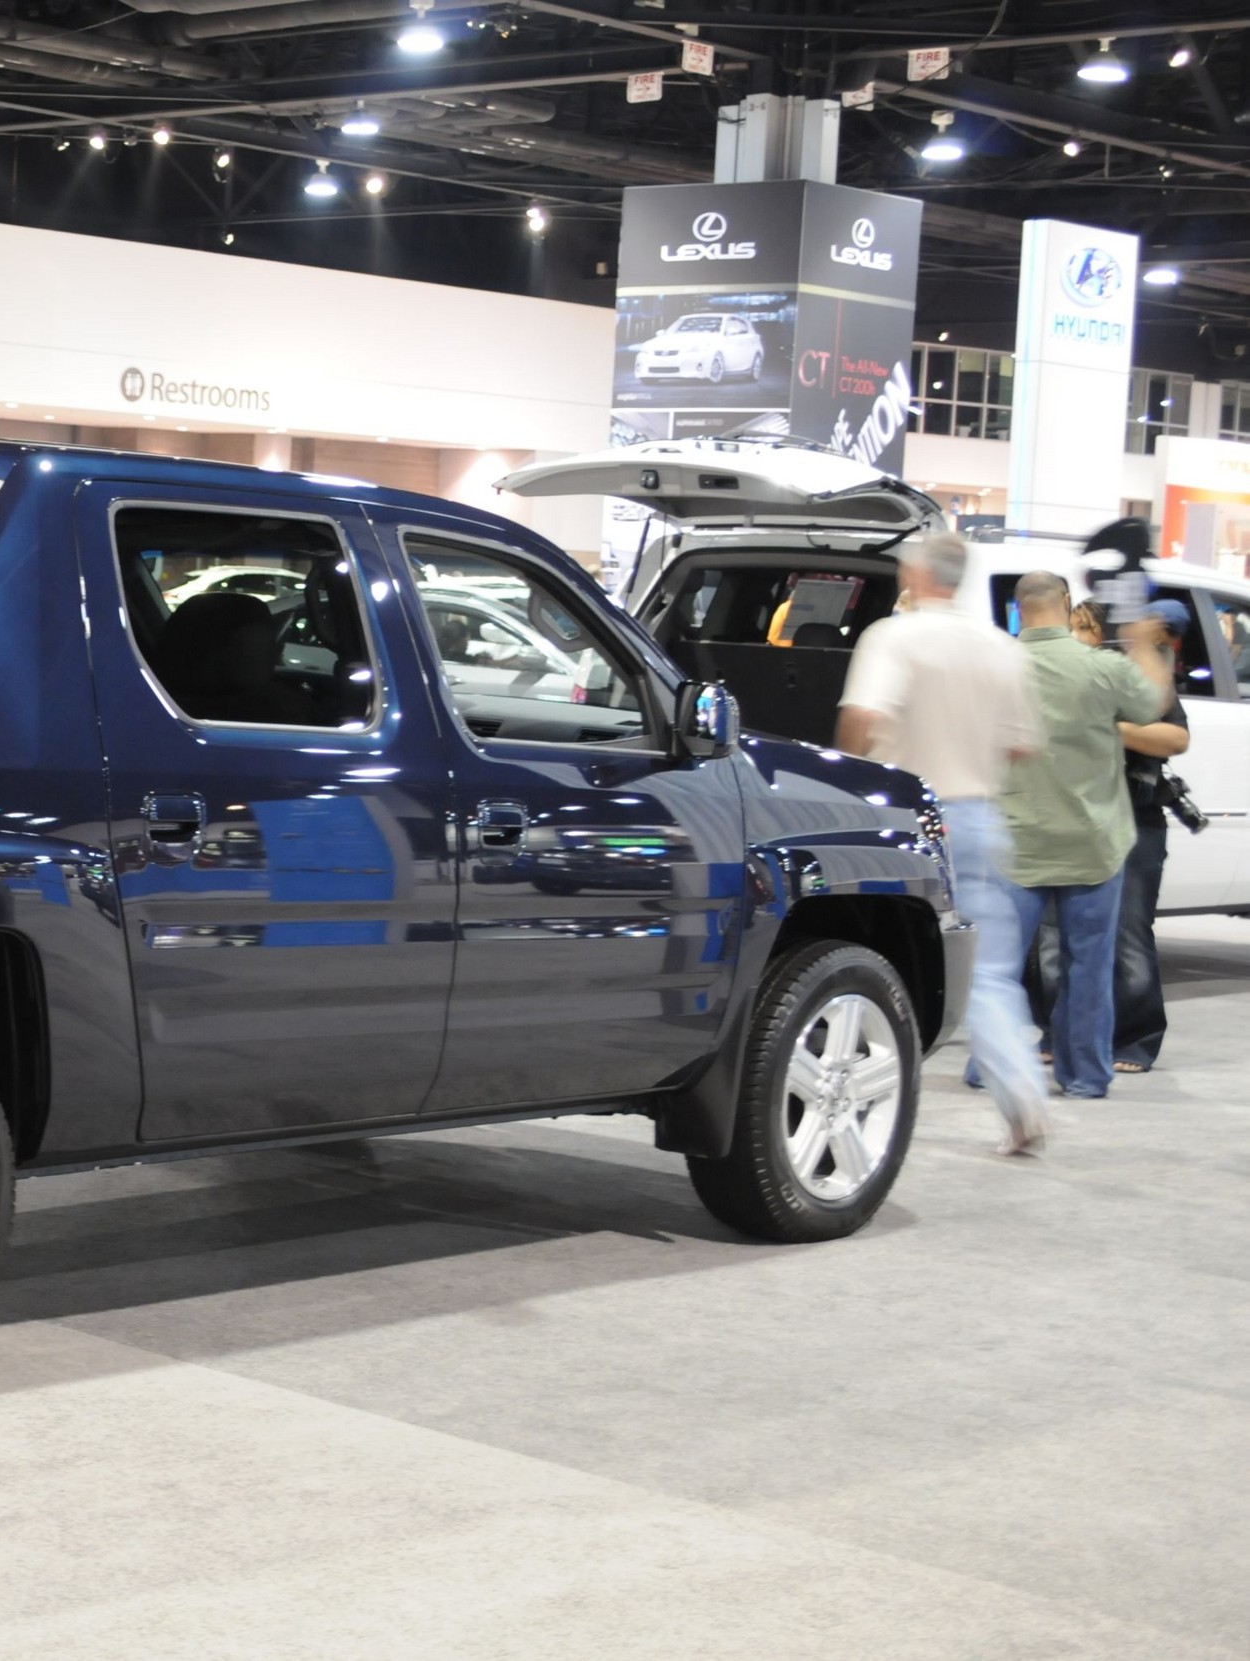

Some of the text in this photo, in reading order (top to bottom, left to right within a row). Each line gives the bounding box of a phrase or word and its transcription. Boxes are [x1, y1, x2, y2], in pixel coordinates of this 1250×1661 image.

[690, 43, 708, 56] FIRE
[915, 51, 940, 62] FIRE
[634, 74, 655, 85] FIRE
[660, 241, 756, 262] LEXUS
[830, 244, 892, 271] LEXUS
[1053, 313, 1126, 346] HYUNDAI
[798, 349, 831, 389] CT
[841, 355, 856, 372] The
[150, 372, 271, 411] Restrooms
[840, 376, 876, 396] CT 200h
